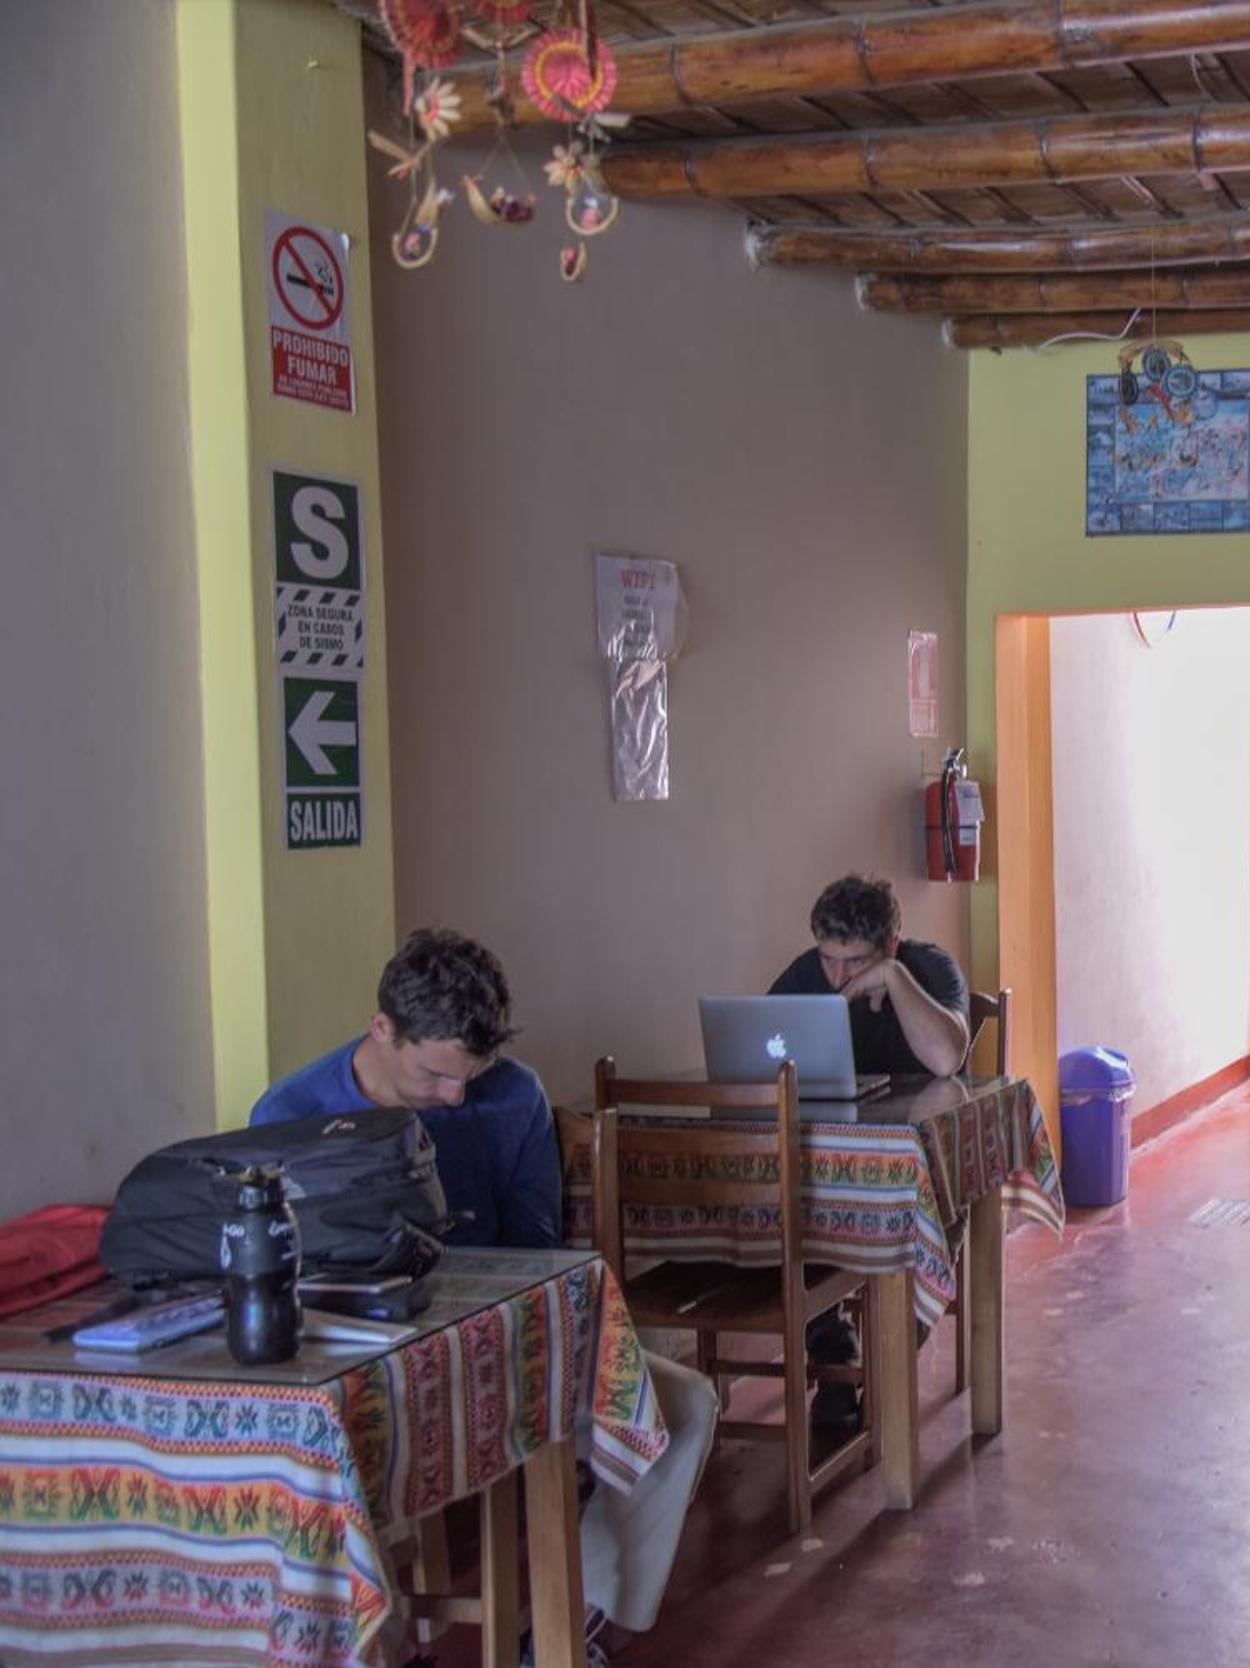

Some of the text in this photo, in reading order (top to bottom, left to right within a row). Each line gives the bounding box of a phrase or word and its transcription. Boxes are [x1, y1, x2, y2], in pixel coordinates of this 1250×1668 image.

[273, 330, 348, 367] PROHIBIDO
[288, 355, 336, 385] FUMAR
[290, 486, 349, 580] S
[288, 604, 352, 621] ZONA SEGURA
[298, 620, 311, 634] EN
[300, 636, 344, 650] DE SISMO
[290, 800, 358, 841] SALIDA
